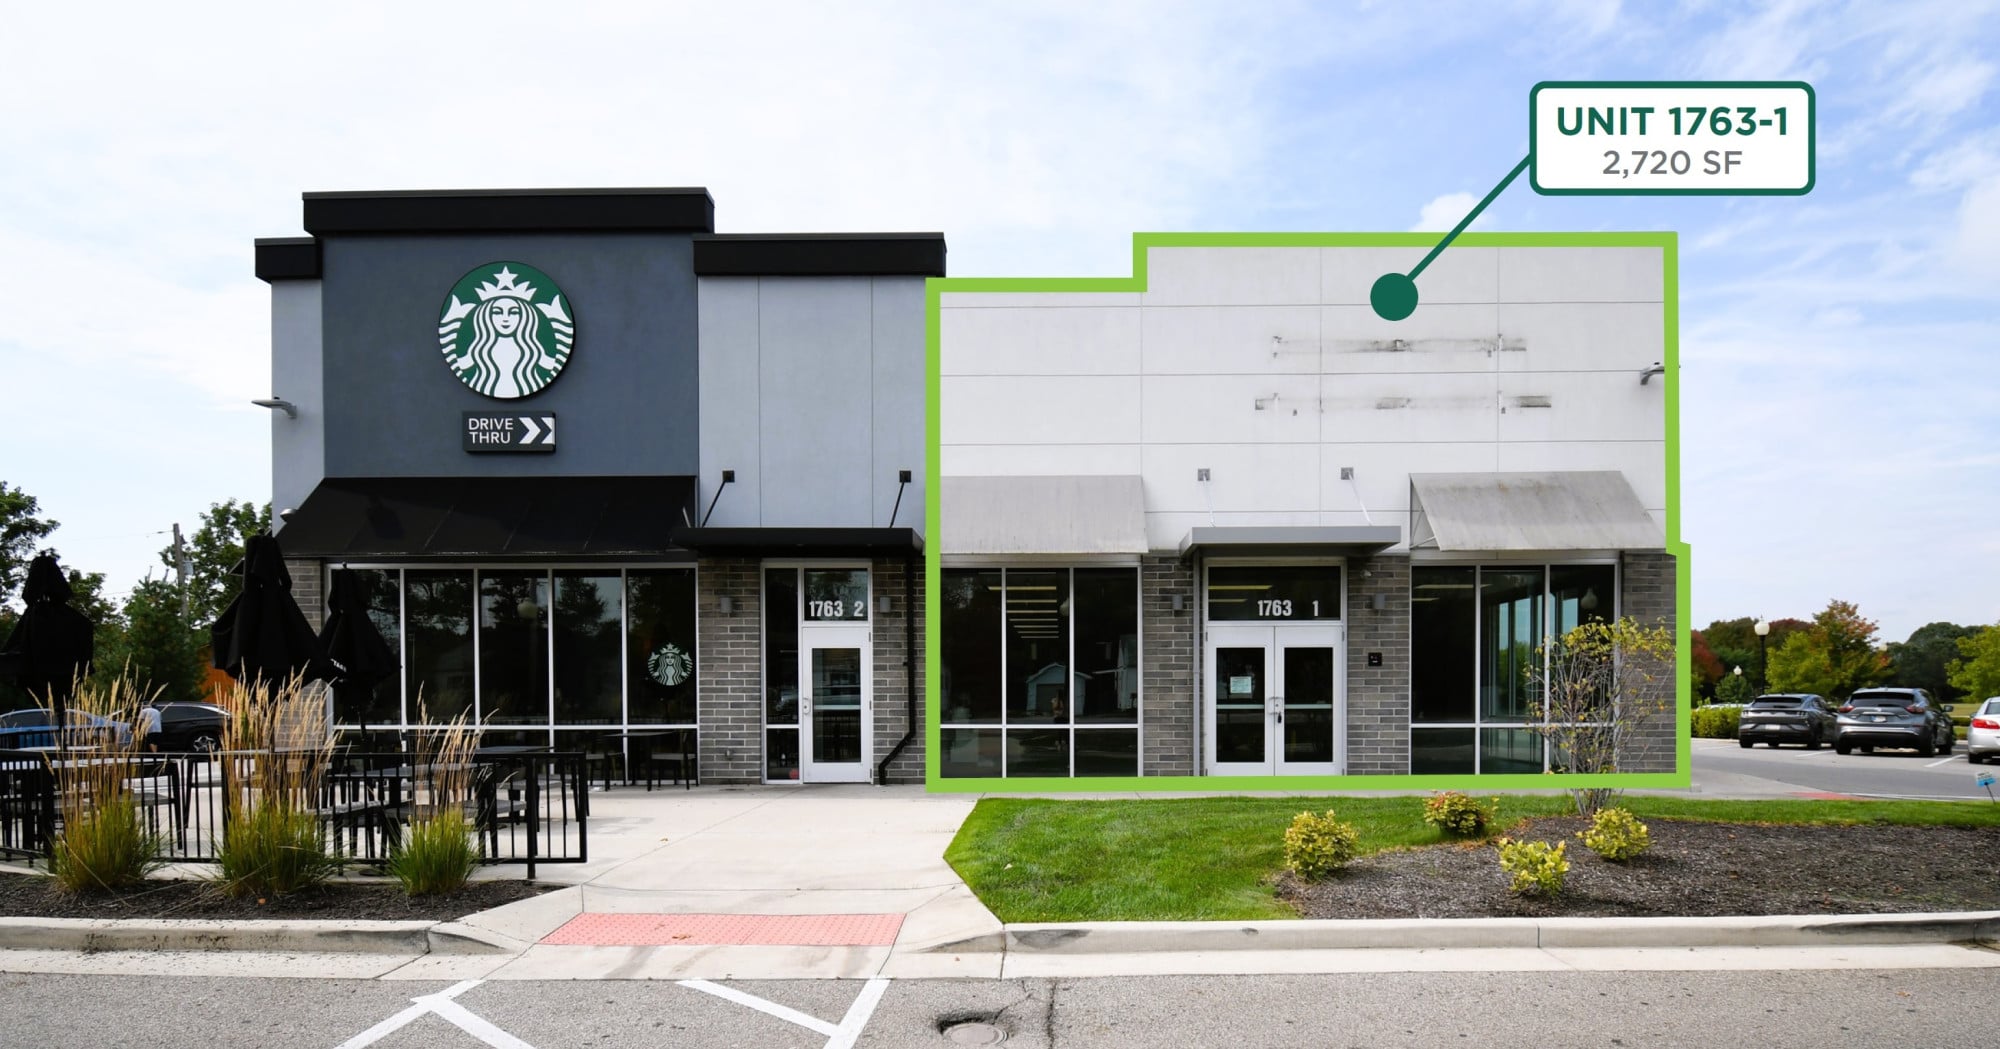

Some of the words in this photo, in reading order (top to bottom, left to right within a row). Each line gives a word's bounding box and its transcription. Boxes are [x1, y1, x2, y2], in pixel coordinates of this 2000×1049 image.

[468, 418, 514, 431] DRIVE
[469, 431, 511, 444] THRU
[809, 600, 844, 617] 1763
[853, 601, 864, 617] 2
[1257, 600, 1293, 616] 1763
[1312, 600, 1319, 616] 1
